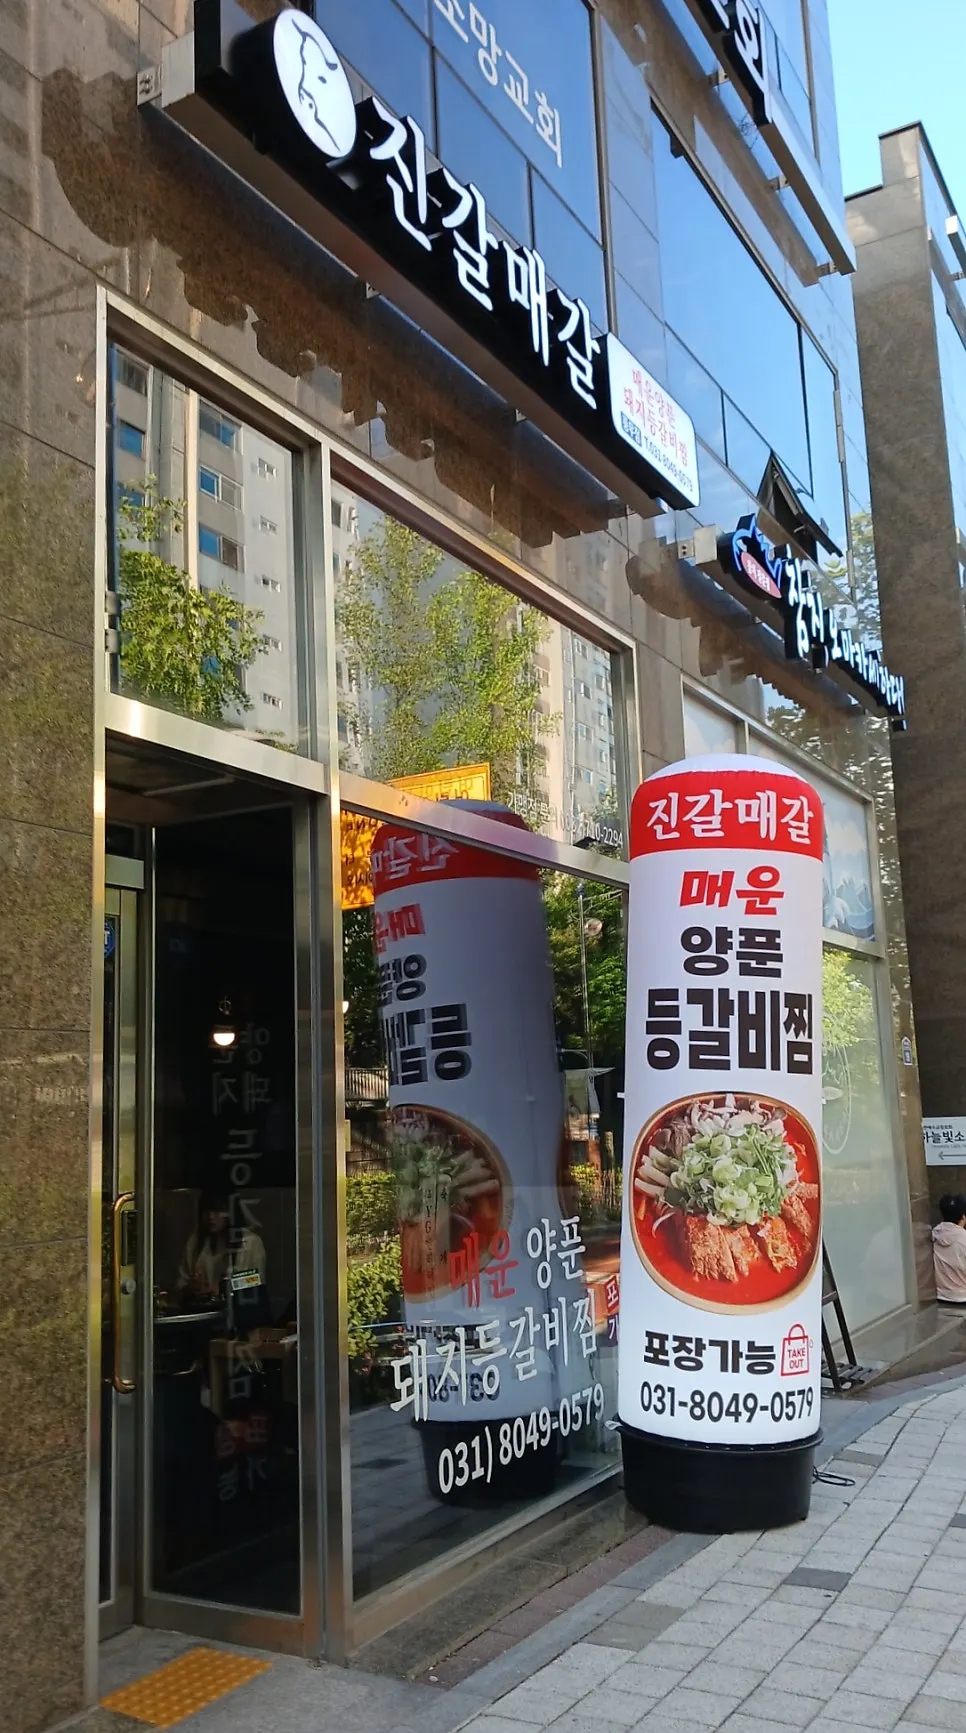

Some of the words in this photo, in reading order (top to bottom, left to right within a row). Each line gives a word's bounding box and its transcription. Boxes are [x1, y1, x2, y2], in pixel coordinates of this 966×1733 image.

[369, 97, 600, 410] 진갈매갈
[646, 788, 815, 845] 진갈매갈
[680, 865, 785, 916] 매운
[680, 926, 784, 979] 양푼
[645, 987, 813, 1075] 등갈비찜
[448, 1230, 519, 1309] 매운
[526, 1215, 587, 1290] 양푼
[389, 1287, 599, 1423] 돼지등갈비찜
[643, 1330, 776, 1375] 포장가능
[786, 1348, 806, 1359] TAKE
[788, 1358, 805, 1369] OUT
[640, 1381, 814, 1423] 031-8049-0579
[438, 1426, 493, 1495] 031)
[499, 1383, 605, 1467] 8049-0579
